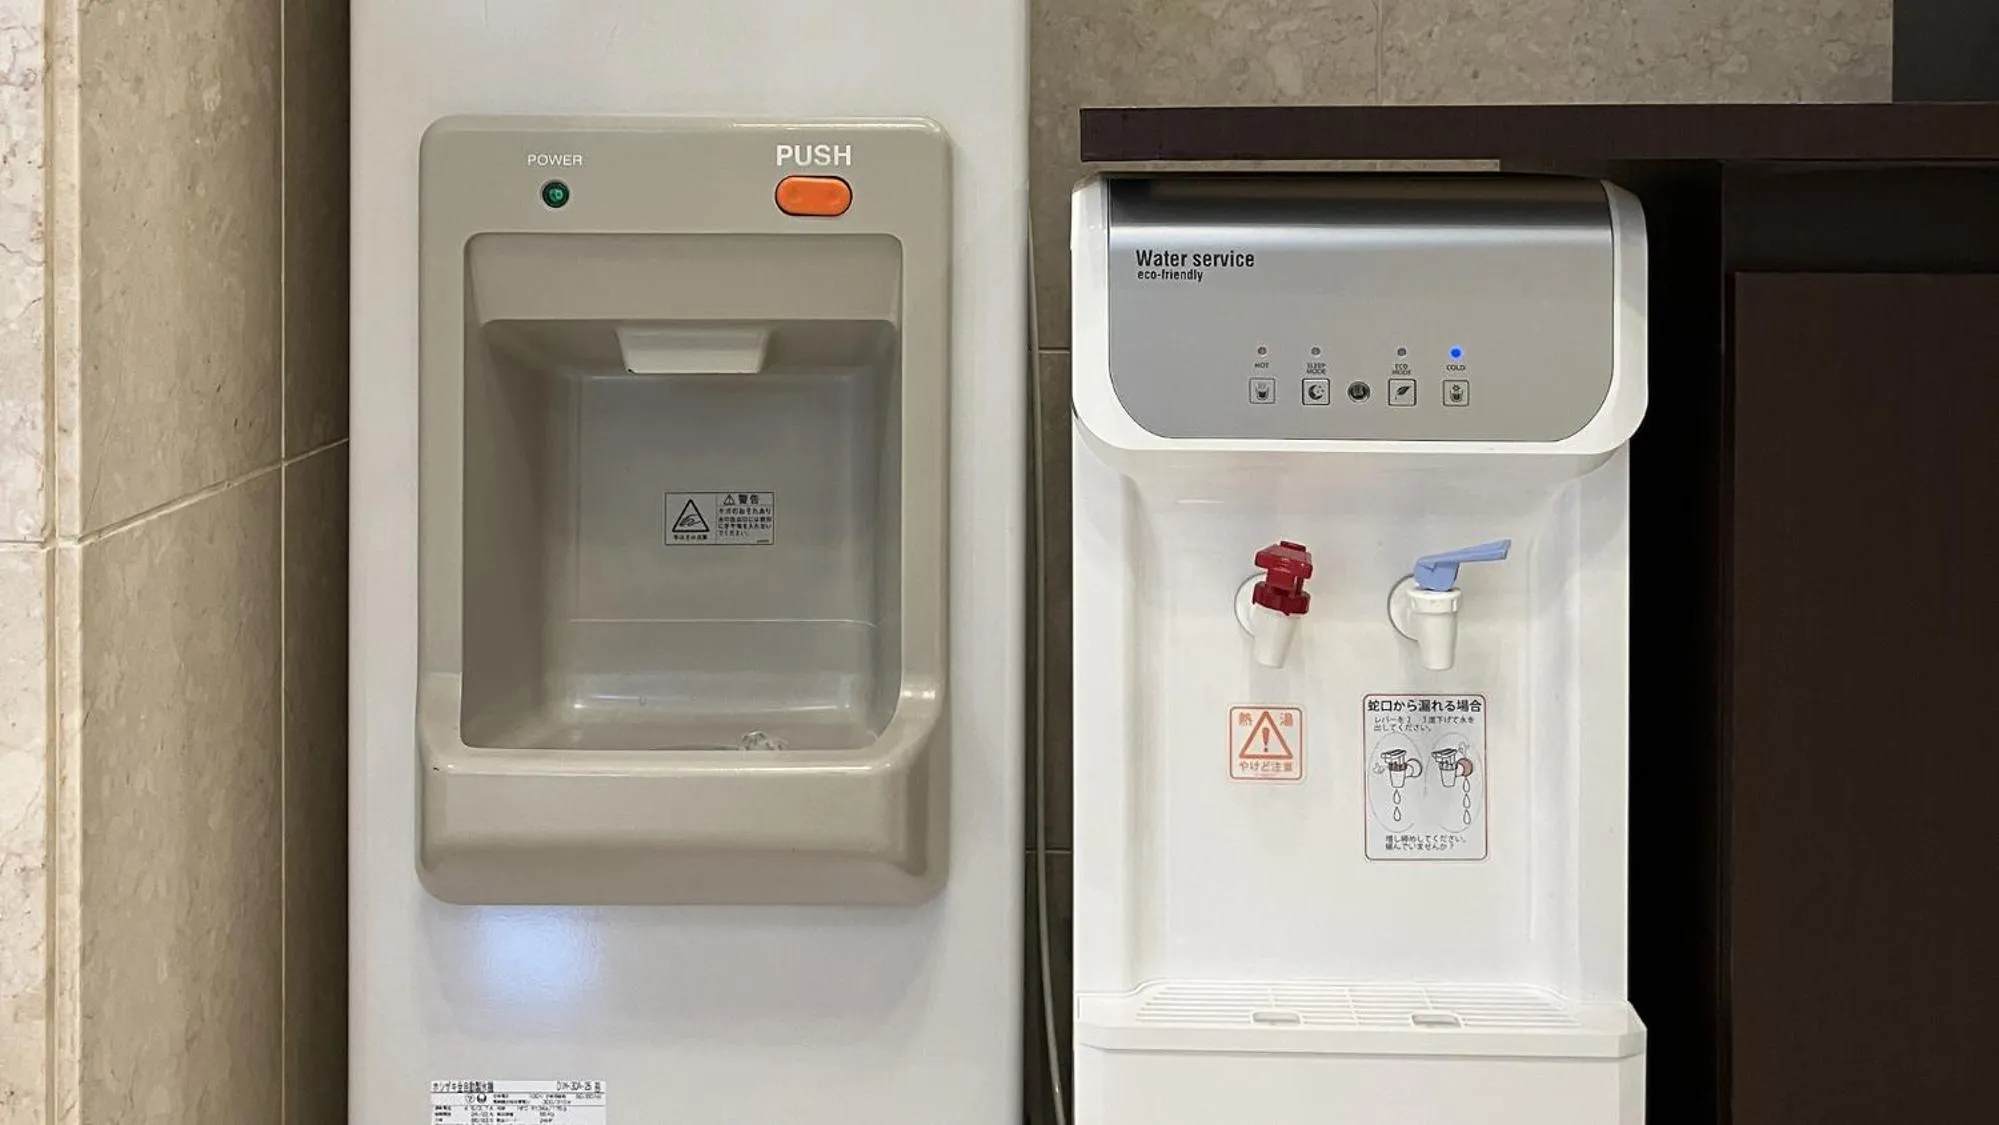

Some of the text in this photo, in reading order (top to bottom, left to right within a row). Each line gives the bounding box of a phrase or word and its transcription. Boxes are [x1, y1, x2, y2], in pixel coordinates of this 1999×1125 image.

[527, 154, 583, 166] POWER
[776, 145, 852, 166] PUSH
[1136, 250, 1255, 267] Water service
[1137, 269, 1203, 282] eco-friendly
[738, 494, 759, 504] 警告
[1367, 699, 1482, 713] 蛇口から漏れる場合
[1238, 761, 1293, 773] やけど注意
